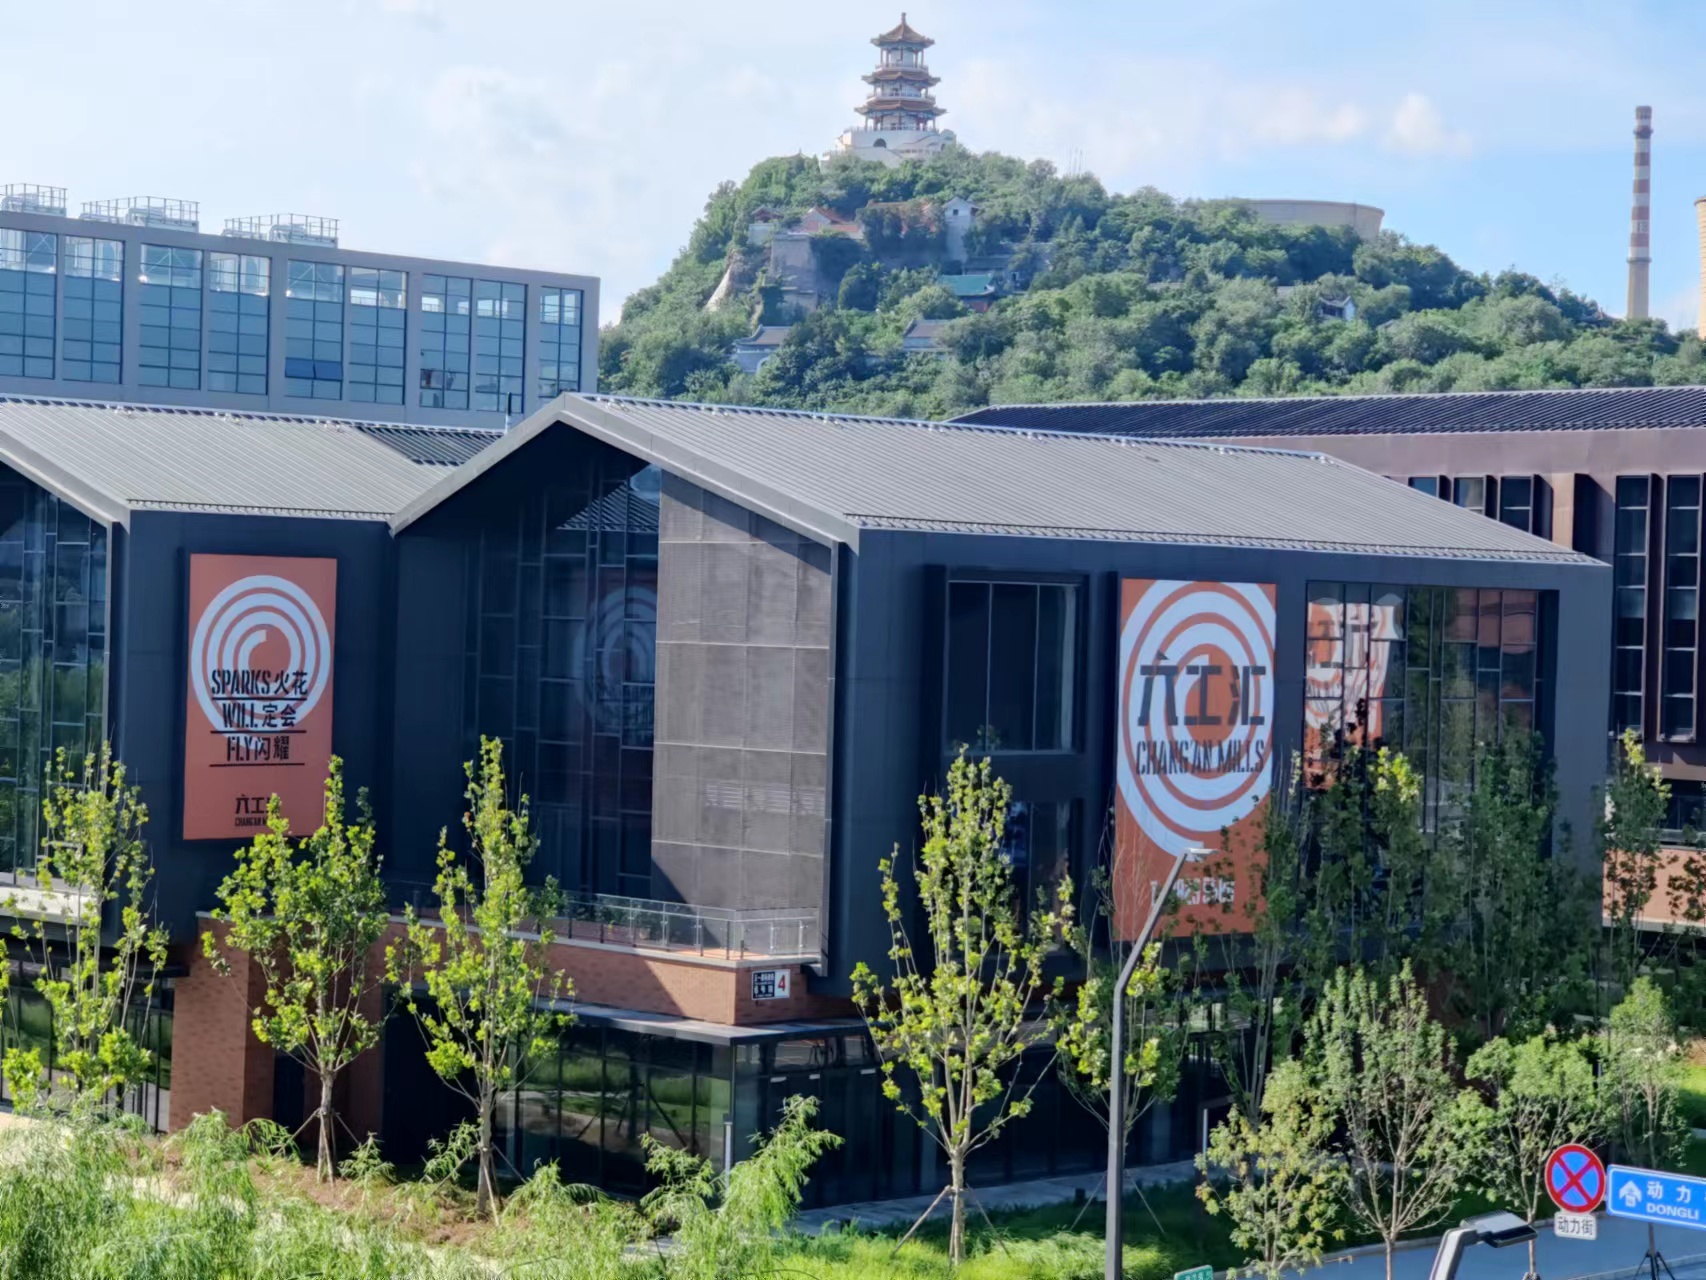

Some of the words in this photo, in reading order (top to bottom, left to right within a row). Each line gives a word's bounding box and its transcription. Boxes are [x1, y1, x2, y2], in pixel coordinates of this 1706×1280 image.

[212, 669, 272, 696] SPARKS
[274, 669, 309, 696] 火花
[1137, 650, 1266, 727] 六工汇
[222, 702, 259, 728] WILL
[262, 703, 297, 728] 定会
[227, 735, 253, 762] FLY
[254, 735, 290, 761] 闪耀
[1136, 739, 1213, 776] CHANG'AN
[1217, 738, 1266, 774] MILLS
[235, 793, 271, 815] 六工
[777, 974, 786, 992] 4
[1646, 1202, 1700, 1221] DONGLI
[1557, 1215, 1594, 1236] 动力街
